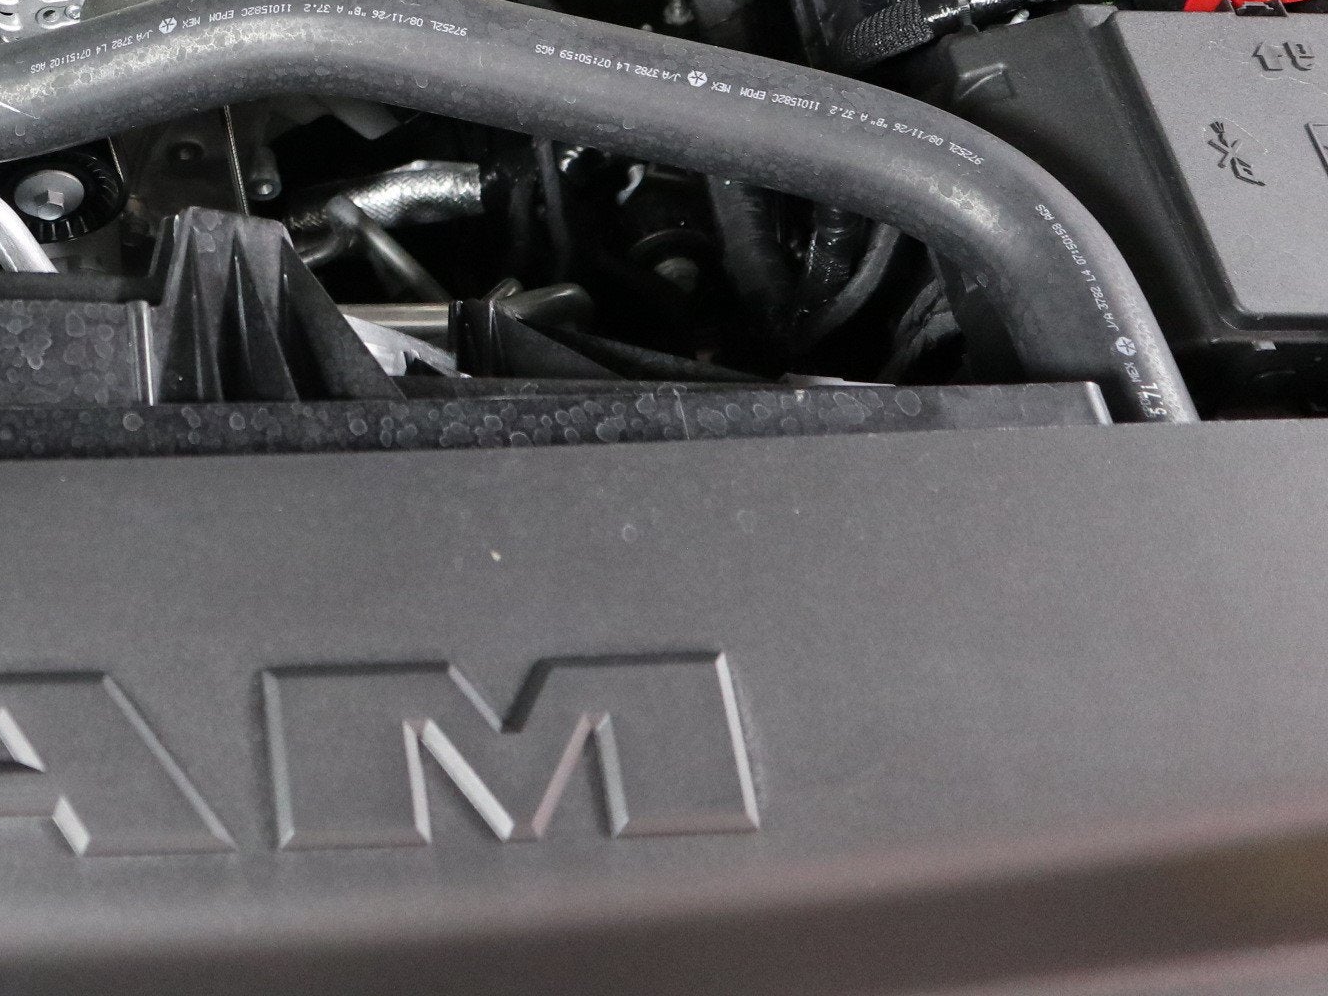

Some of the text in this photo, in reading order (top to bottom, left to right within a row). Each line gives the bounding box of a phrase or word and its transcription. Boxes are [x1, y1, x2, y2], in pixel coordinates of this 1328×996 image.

[240, 3, 292, 17] 1101582C
[303, 3, 331, 13] 37.2
[336, 5, 344, 14] A
[181, 16, 201, 29] MEX
[209, 9, 234, 23] EPDM
[371, 9, 423, 25] 08/11/26
[429, 19, 468, 37] 97252L
[136, 29, 153, 42] J/A
[96, 43, 107, 55] L4
[111, 36, 133, 50] 3782
[535, 44, 555, 56] AGS
[49, 49, 91, 69] 07:51:02
[559, 49, 612, 69] 07:50:59
[30, 61, 46, 74] AGS
[616, 61, 630, 73] L4
[635, 64, 660, 79] 3782
[662, 70, 681, 82] J/A
[711, 81, 732, 94] MEX
[740, 86, 767, 100] EPDM
[771, 92, 820, 111] 1101582C
[829, 105, 855, 120] 37.2
[860, 112, 869, 123] A
[892, 122, 944, 147] 08/11/26
[949, 141, 985, 166] 97252L
[1035, 203, 1055, 221] AGS
[1080, 269, 1097, 282] L4
[1089, 286, 1109, 310] 3782
[1123, 361, 1141, 383] MEX
